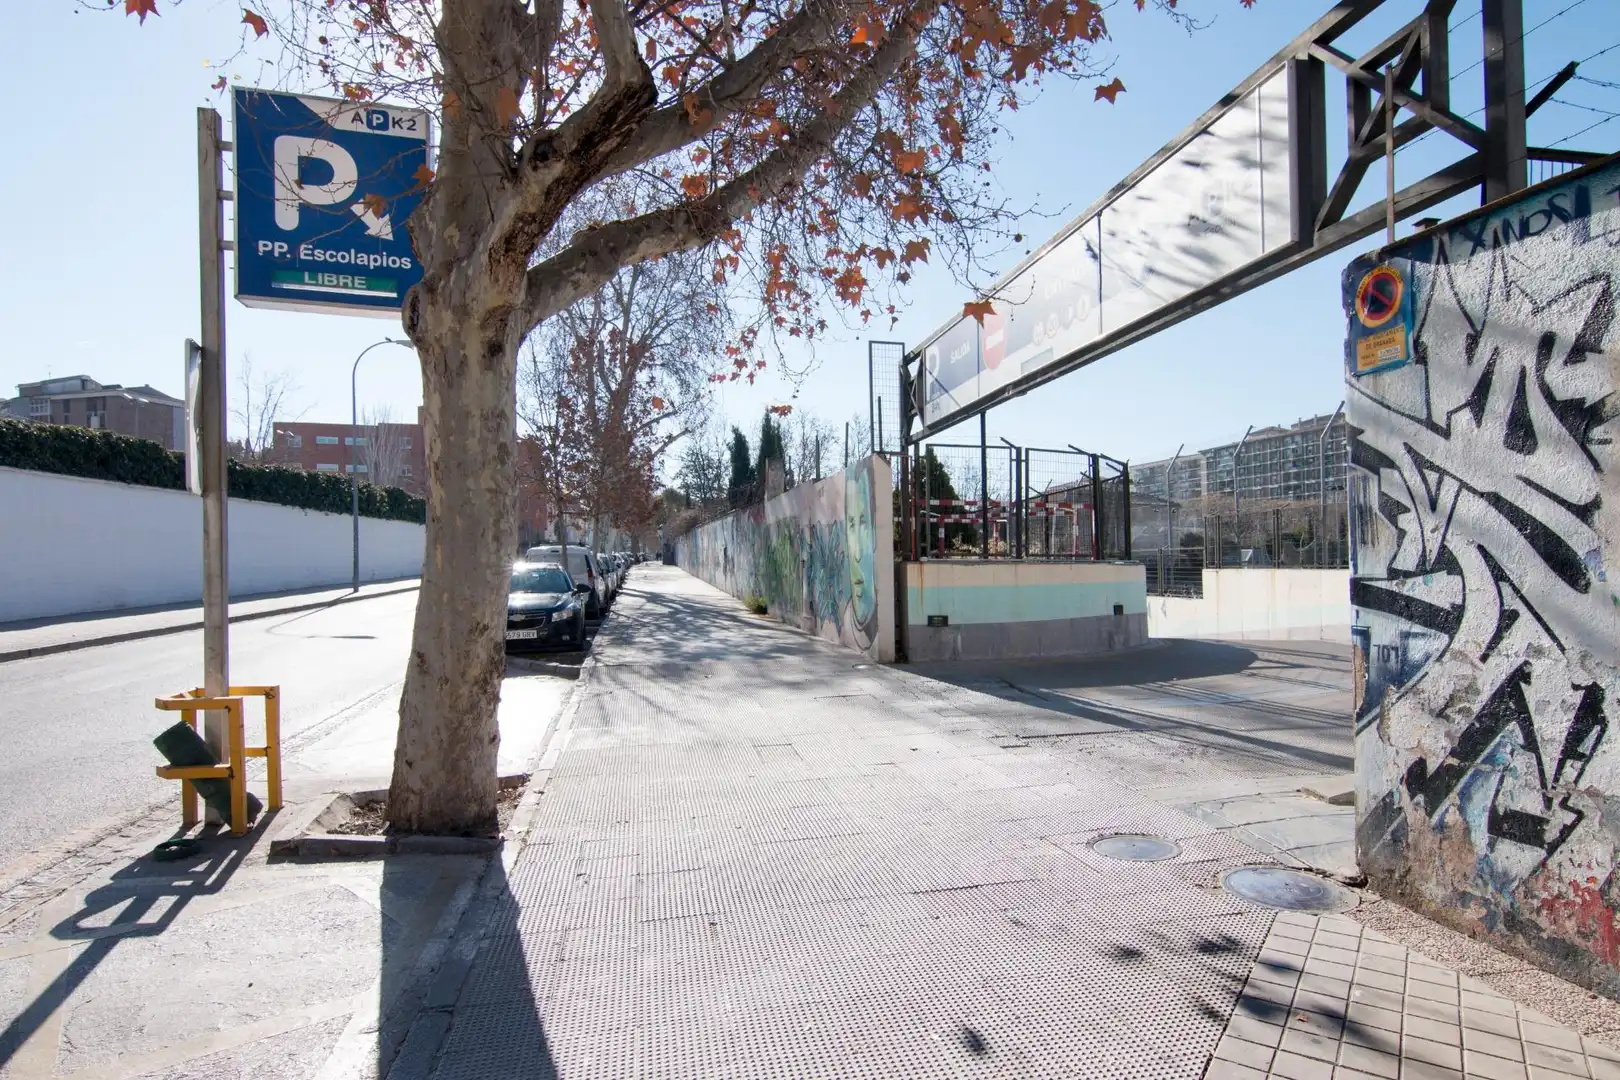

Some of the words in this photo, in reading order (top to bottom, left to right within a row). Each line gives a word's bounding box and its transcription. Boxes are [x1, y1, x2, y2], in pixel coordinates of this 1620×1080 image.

[258, 240, 291, 258] PP.
[300, 244, 412, 270] Escolapios
[304, 272, 367, 289] LIBRE
